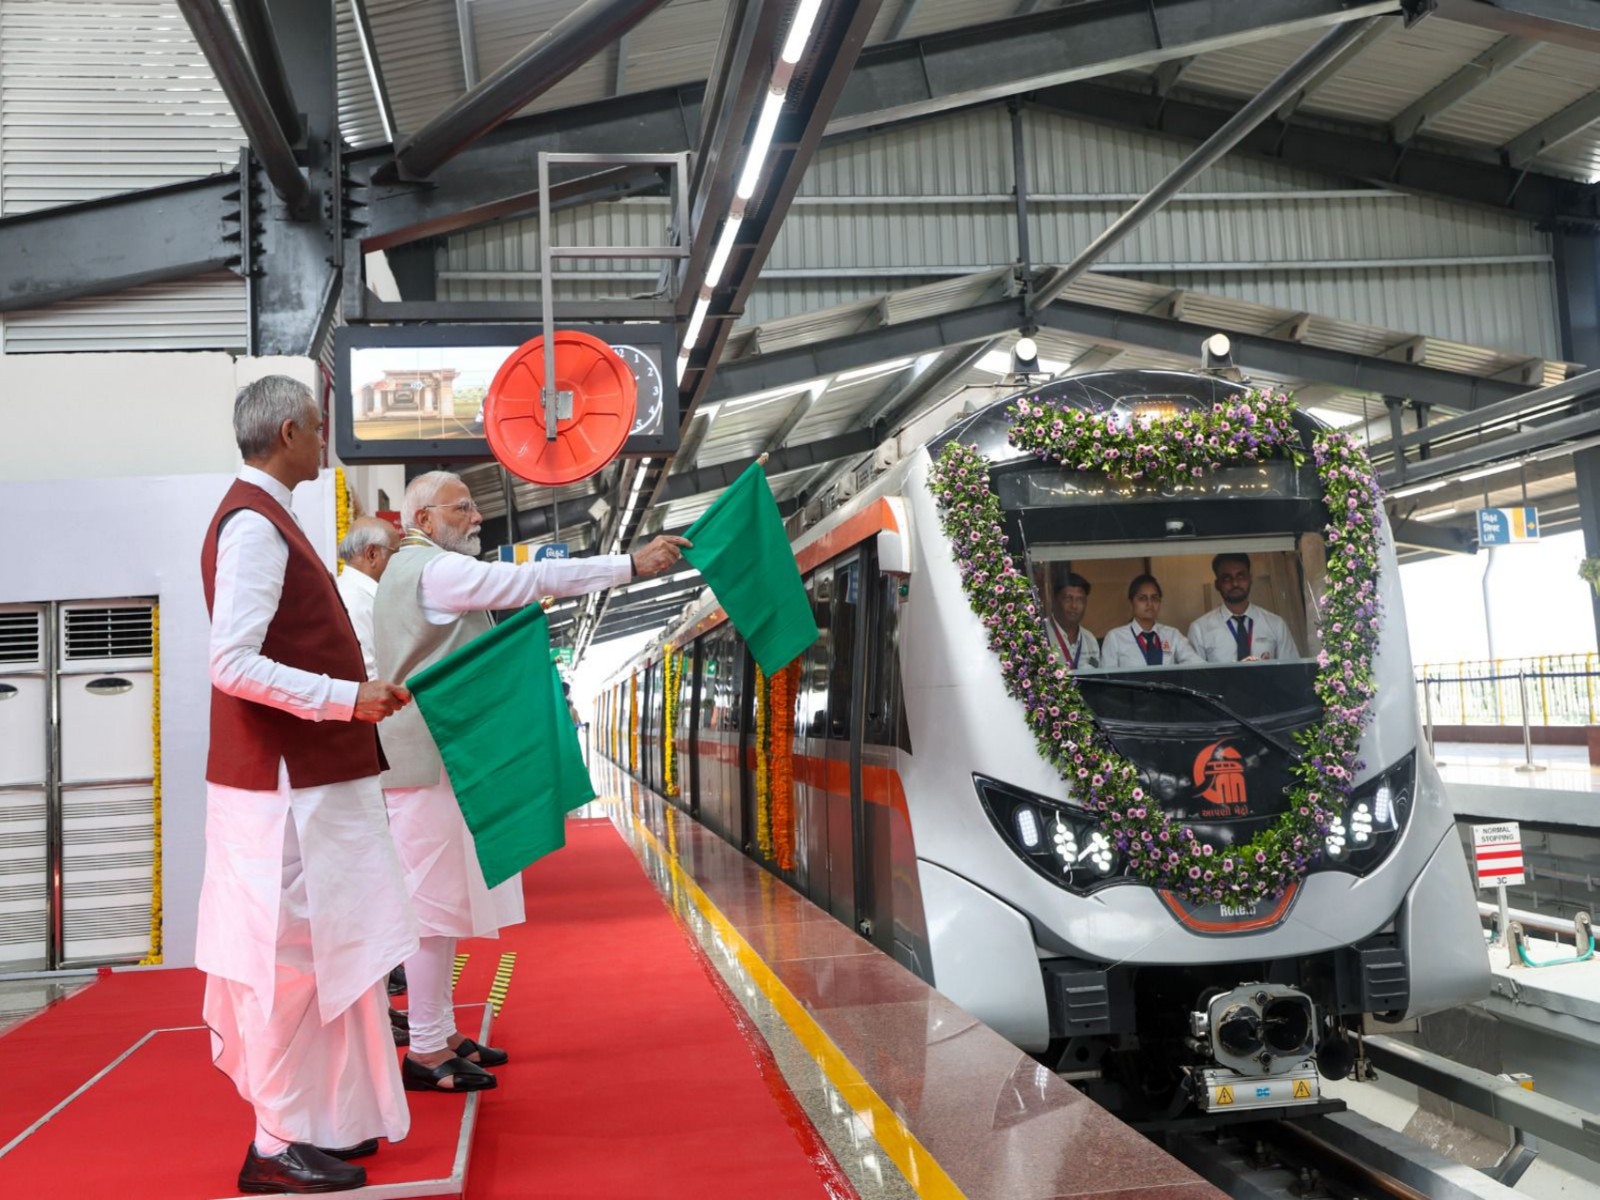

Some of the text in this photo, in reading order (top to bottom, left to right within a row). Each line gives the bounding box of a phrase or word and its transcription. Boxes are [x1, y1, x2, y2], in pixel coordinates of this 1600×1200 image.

[634, 354, 640, 363] 1
[647, 367, 655, 377] 2
[652, 386, 660, 396] 3
[648, 405, 655, 415] 4
[635, 419, 643, 429] 5
[1483, 533, 1495, 542] Lift
[1483, 826, 1510, 834] NORMAL
[1481, 833, 1514, 842] STOPPING
